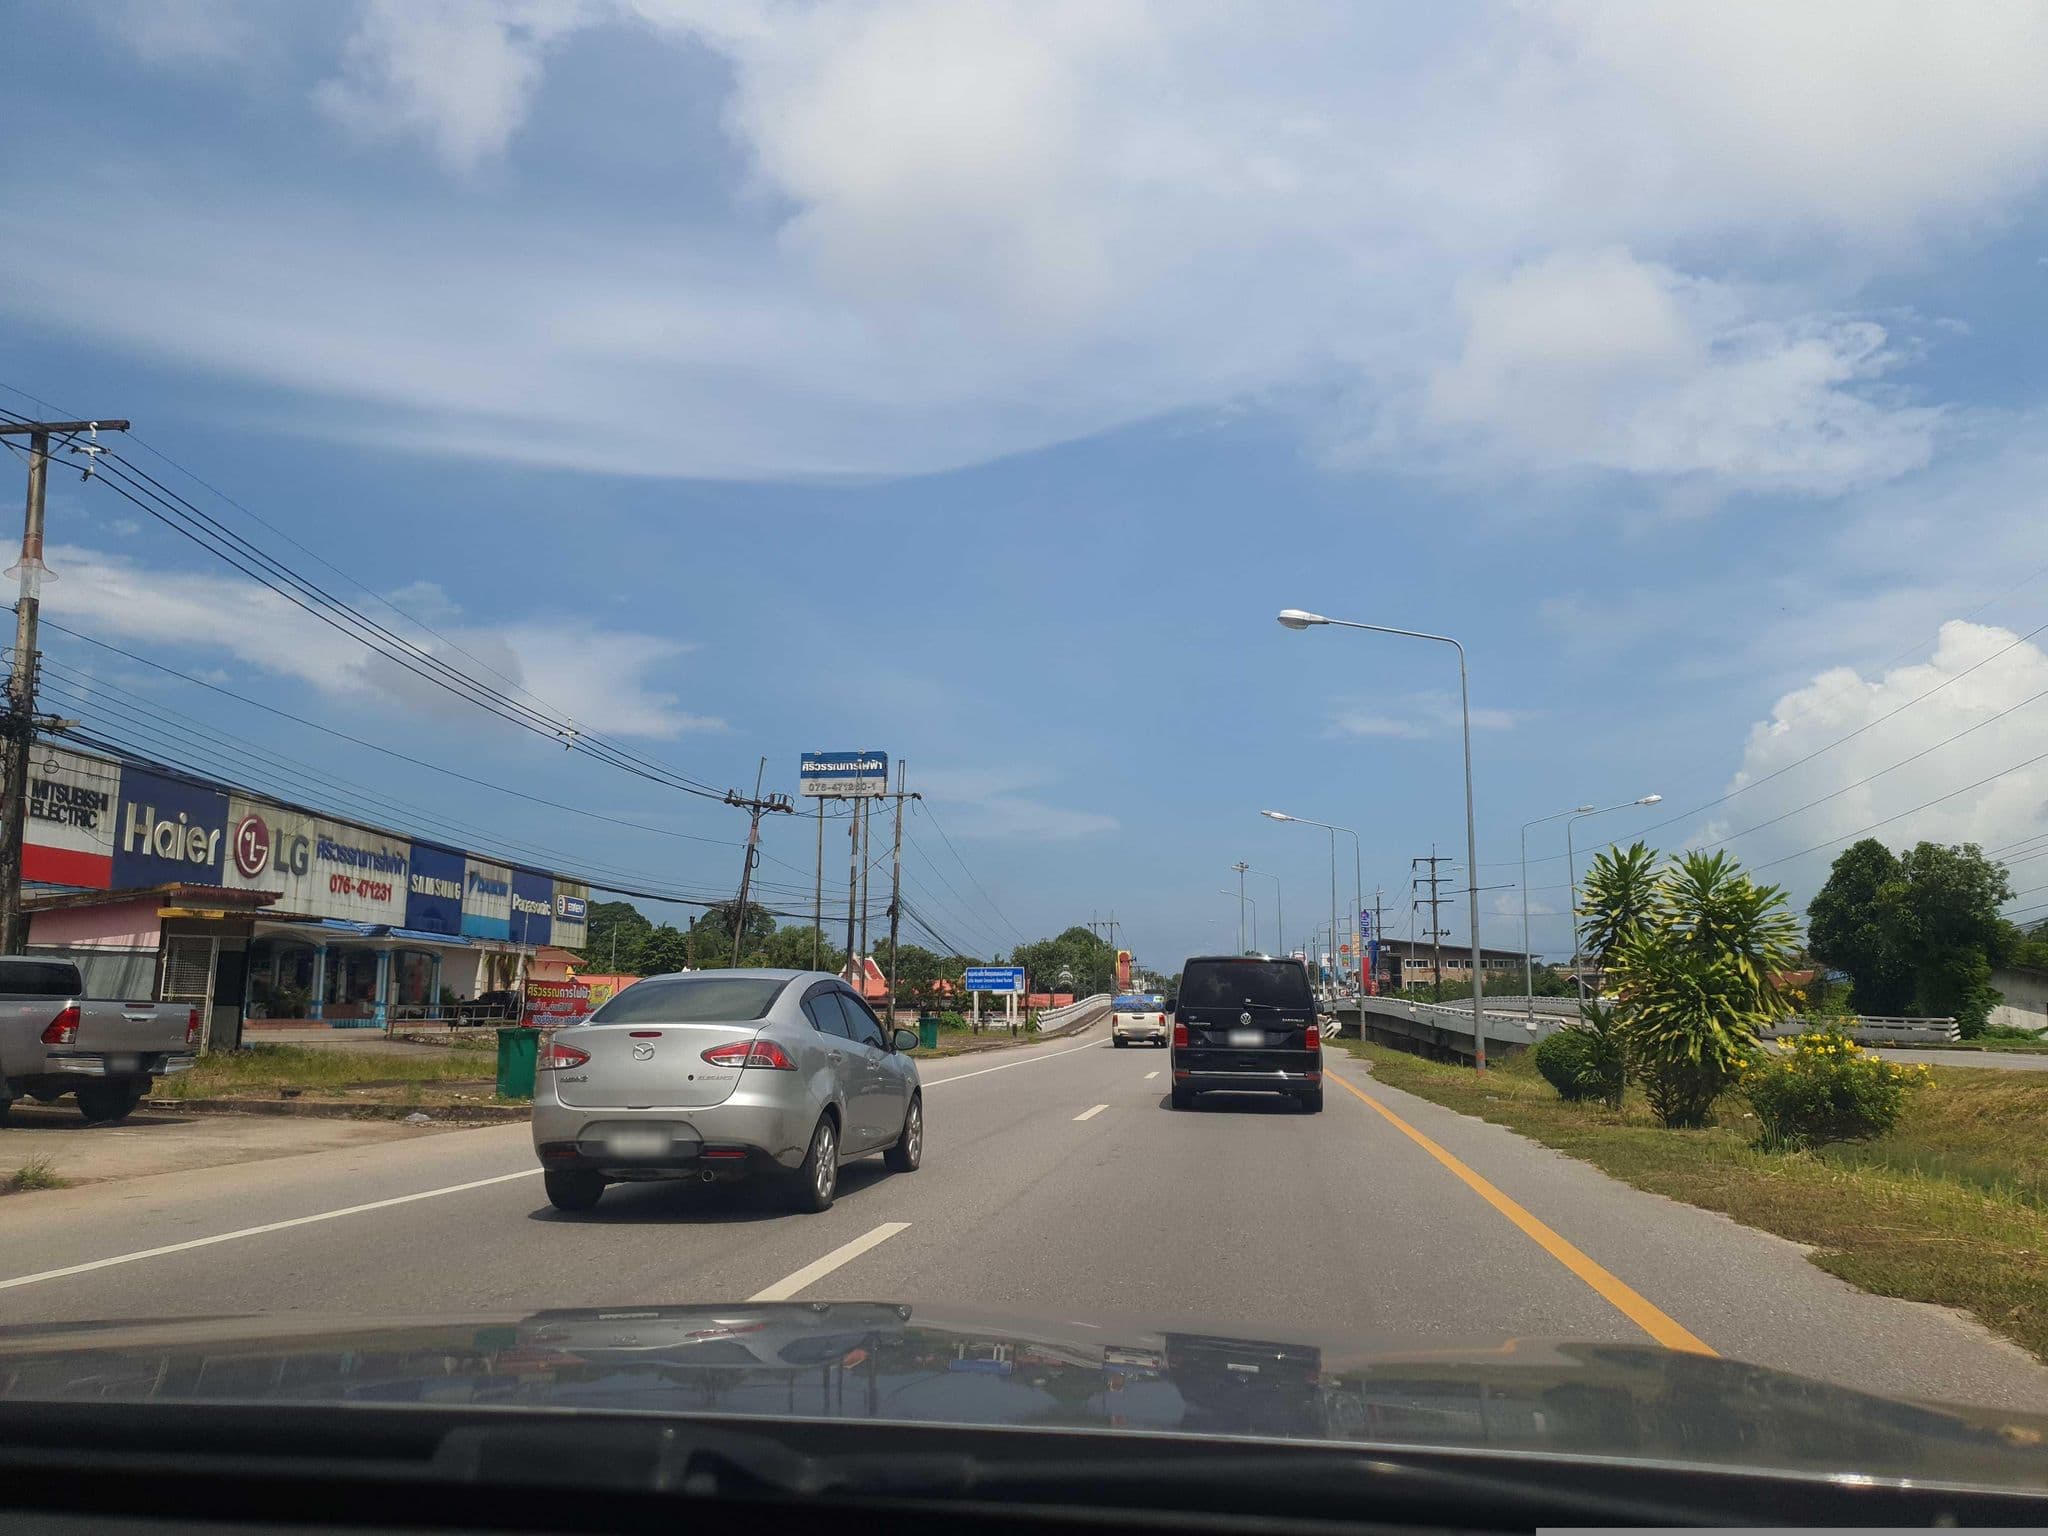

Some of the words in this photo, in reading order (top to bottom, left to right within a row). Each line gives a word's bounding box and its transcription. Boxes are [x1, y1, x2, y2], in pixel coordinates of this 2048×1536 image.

[32, 779, 109, 811] MITSUBISHI
[30, 799, 98, 829] ELECTRIC
[124, 801, 220, 866] Haier
[273, 828, 310, 876] LG
[411, 873, 461, 900] SAMSUNG
[512, 893, 551, 916] Panasonic
